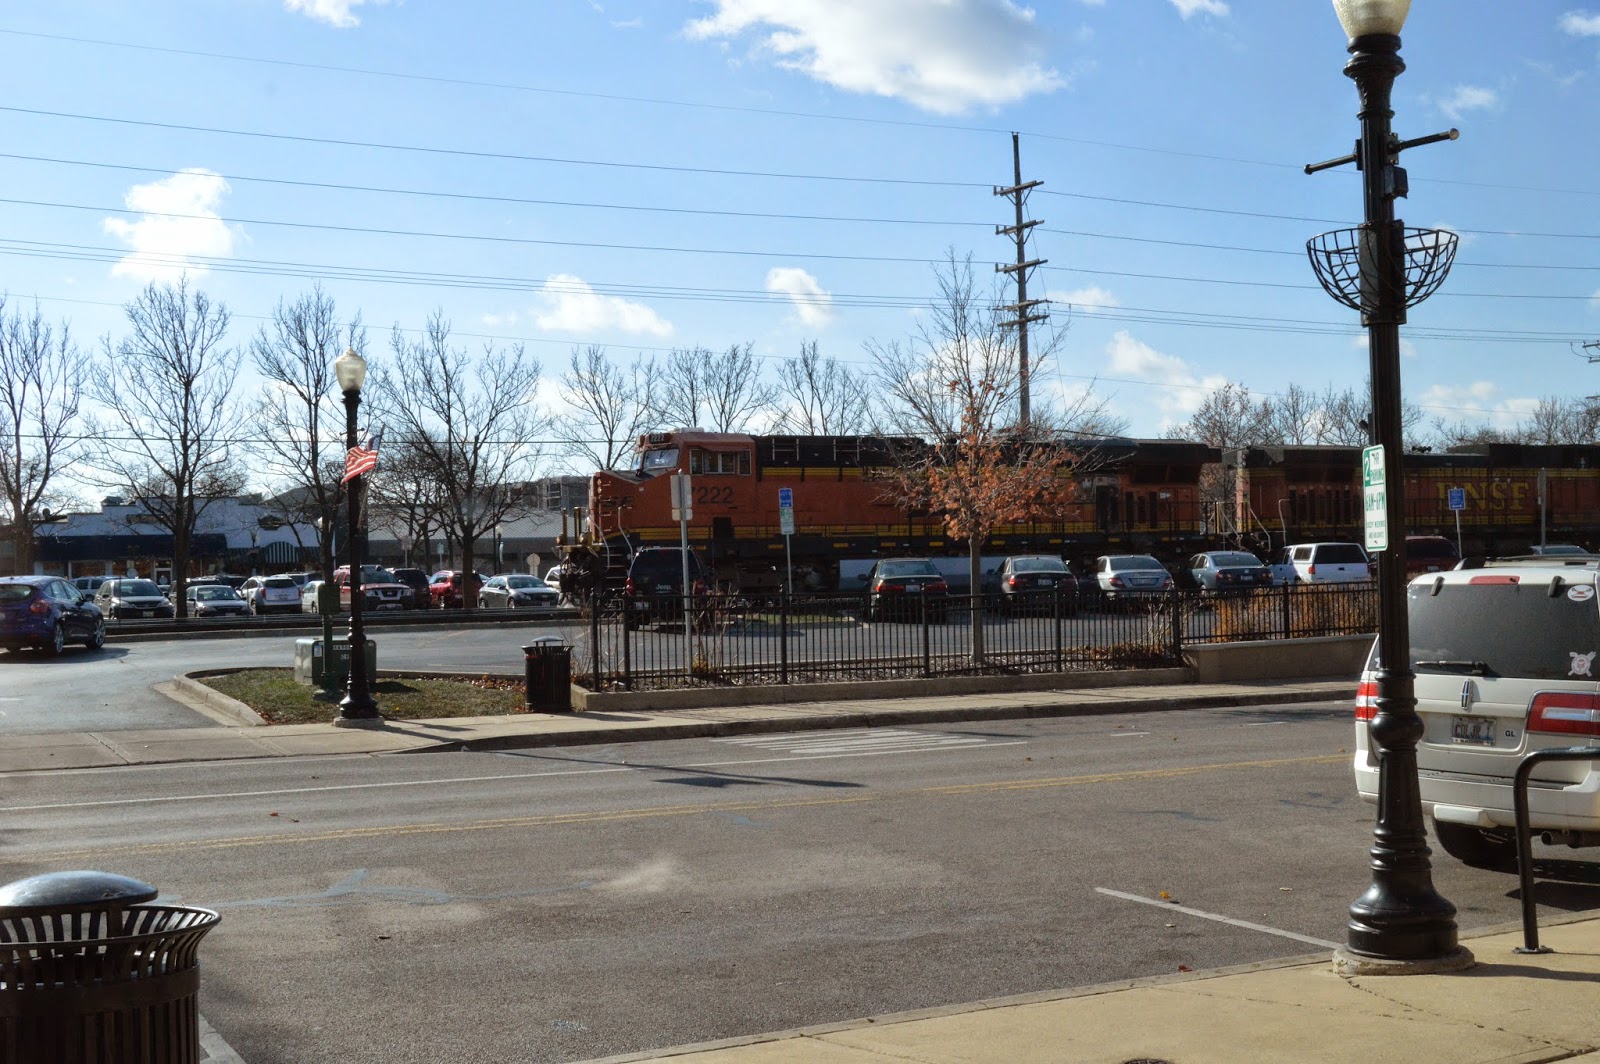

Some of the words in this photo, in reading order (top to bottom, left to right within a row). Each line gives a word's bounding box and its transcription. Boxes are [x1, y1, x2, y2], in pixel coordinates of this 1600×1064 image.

[1364, 456, 1370, 481] 2
[691, 486, 734, 504] 222
[655, 583, 671, 591] Jeep
